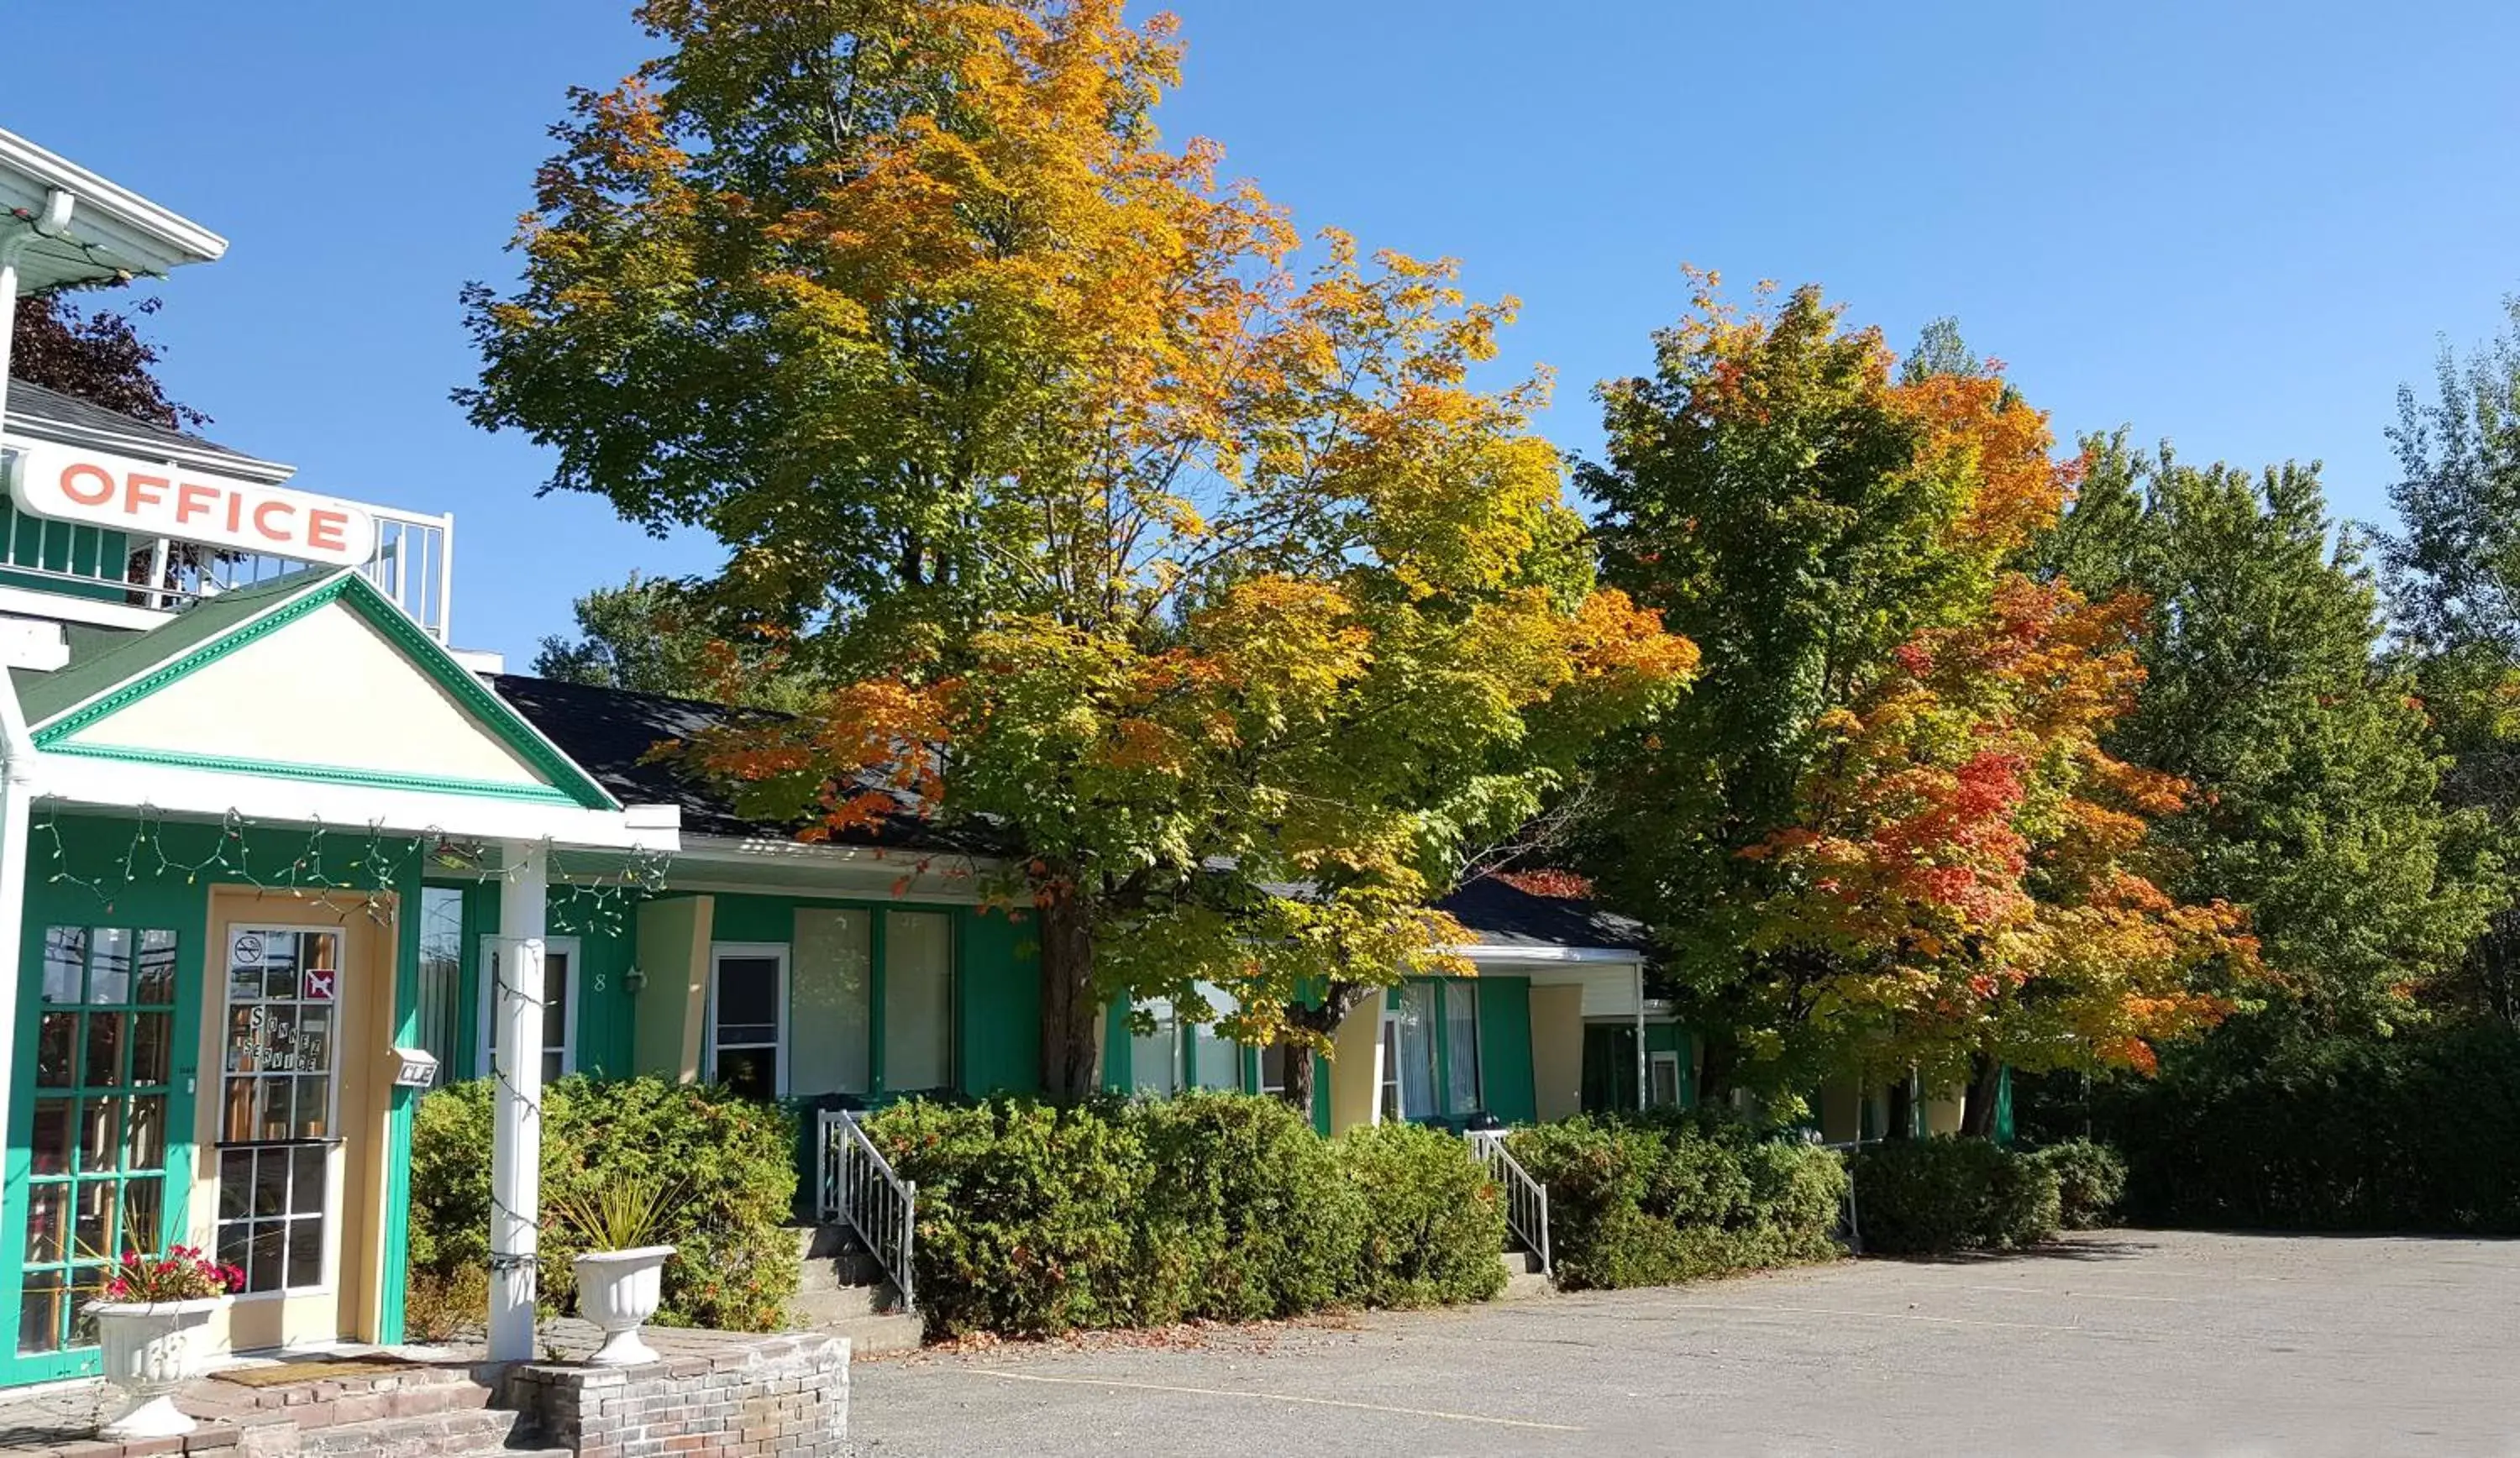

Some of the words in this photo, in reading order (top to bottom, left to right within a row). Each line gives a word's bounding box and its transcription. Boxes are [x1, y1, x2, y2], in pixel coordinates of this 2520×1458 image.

[60, 464, 348, 551] OFFICE
[594, 973, 606, 992] 8
[244, 1040, 317, 1073] SERVICE
